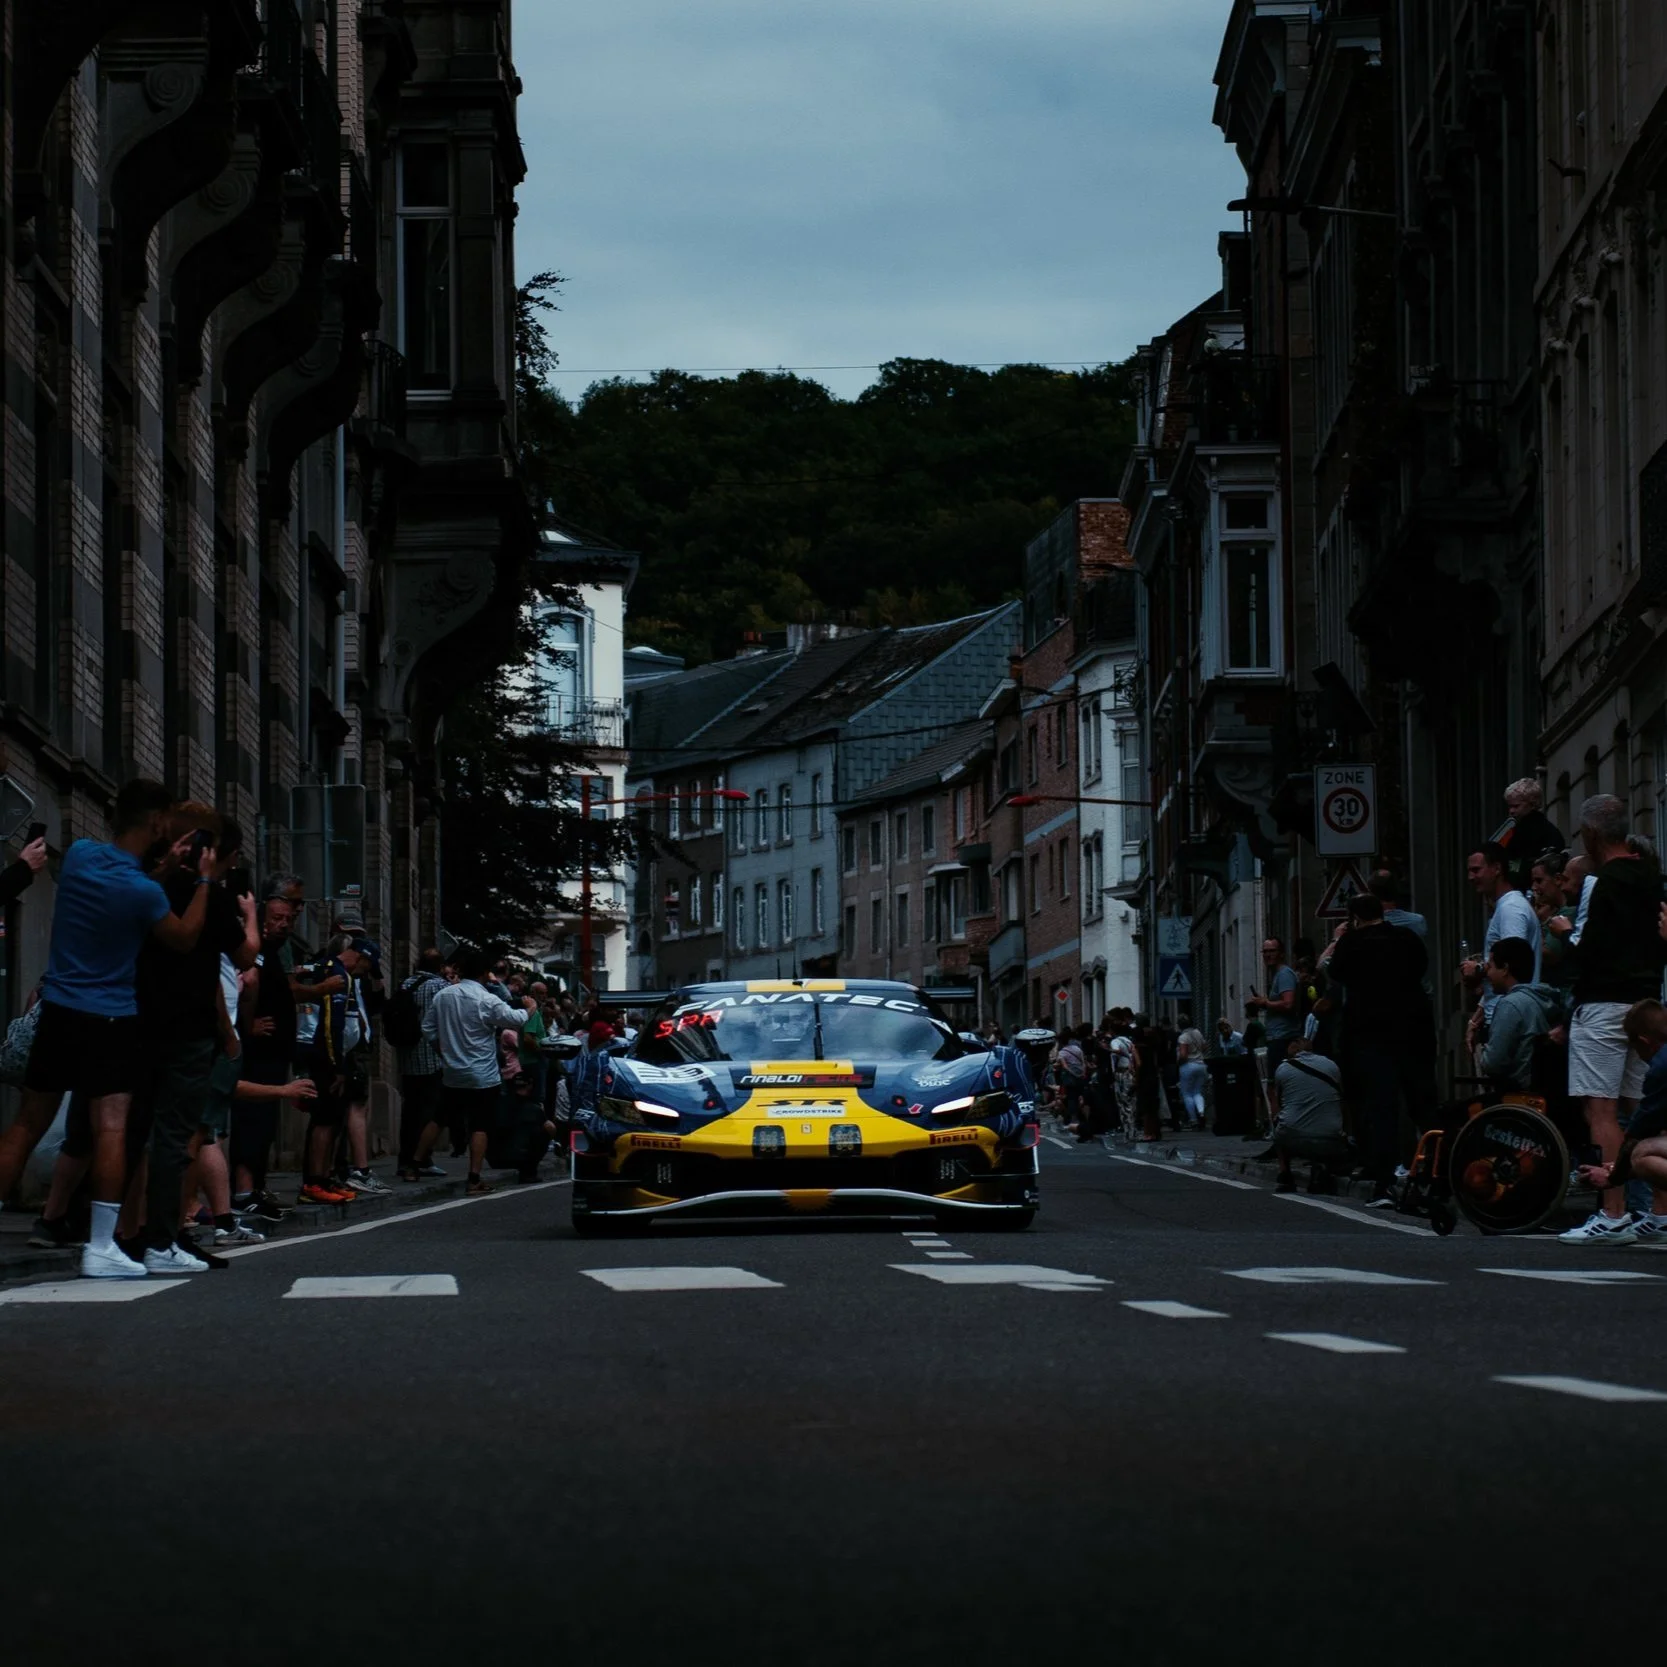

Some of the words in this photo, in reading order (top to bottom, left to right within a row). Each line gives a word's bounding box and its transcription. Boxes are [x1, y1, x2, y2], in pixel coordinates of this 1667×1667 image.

[1324, 772, 1365, 784] ZONE
[1334, 798, 1359, 817] 30
[1339, 817, 1354, 826] km
[672, 993, 918, 1017] FANATEC
[630, 1133, 682, 1149] PIRELLI
[929, 1128, 978, 1145] PIRELLI
